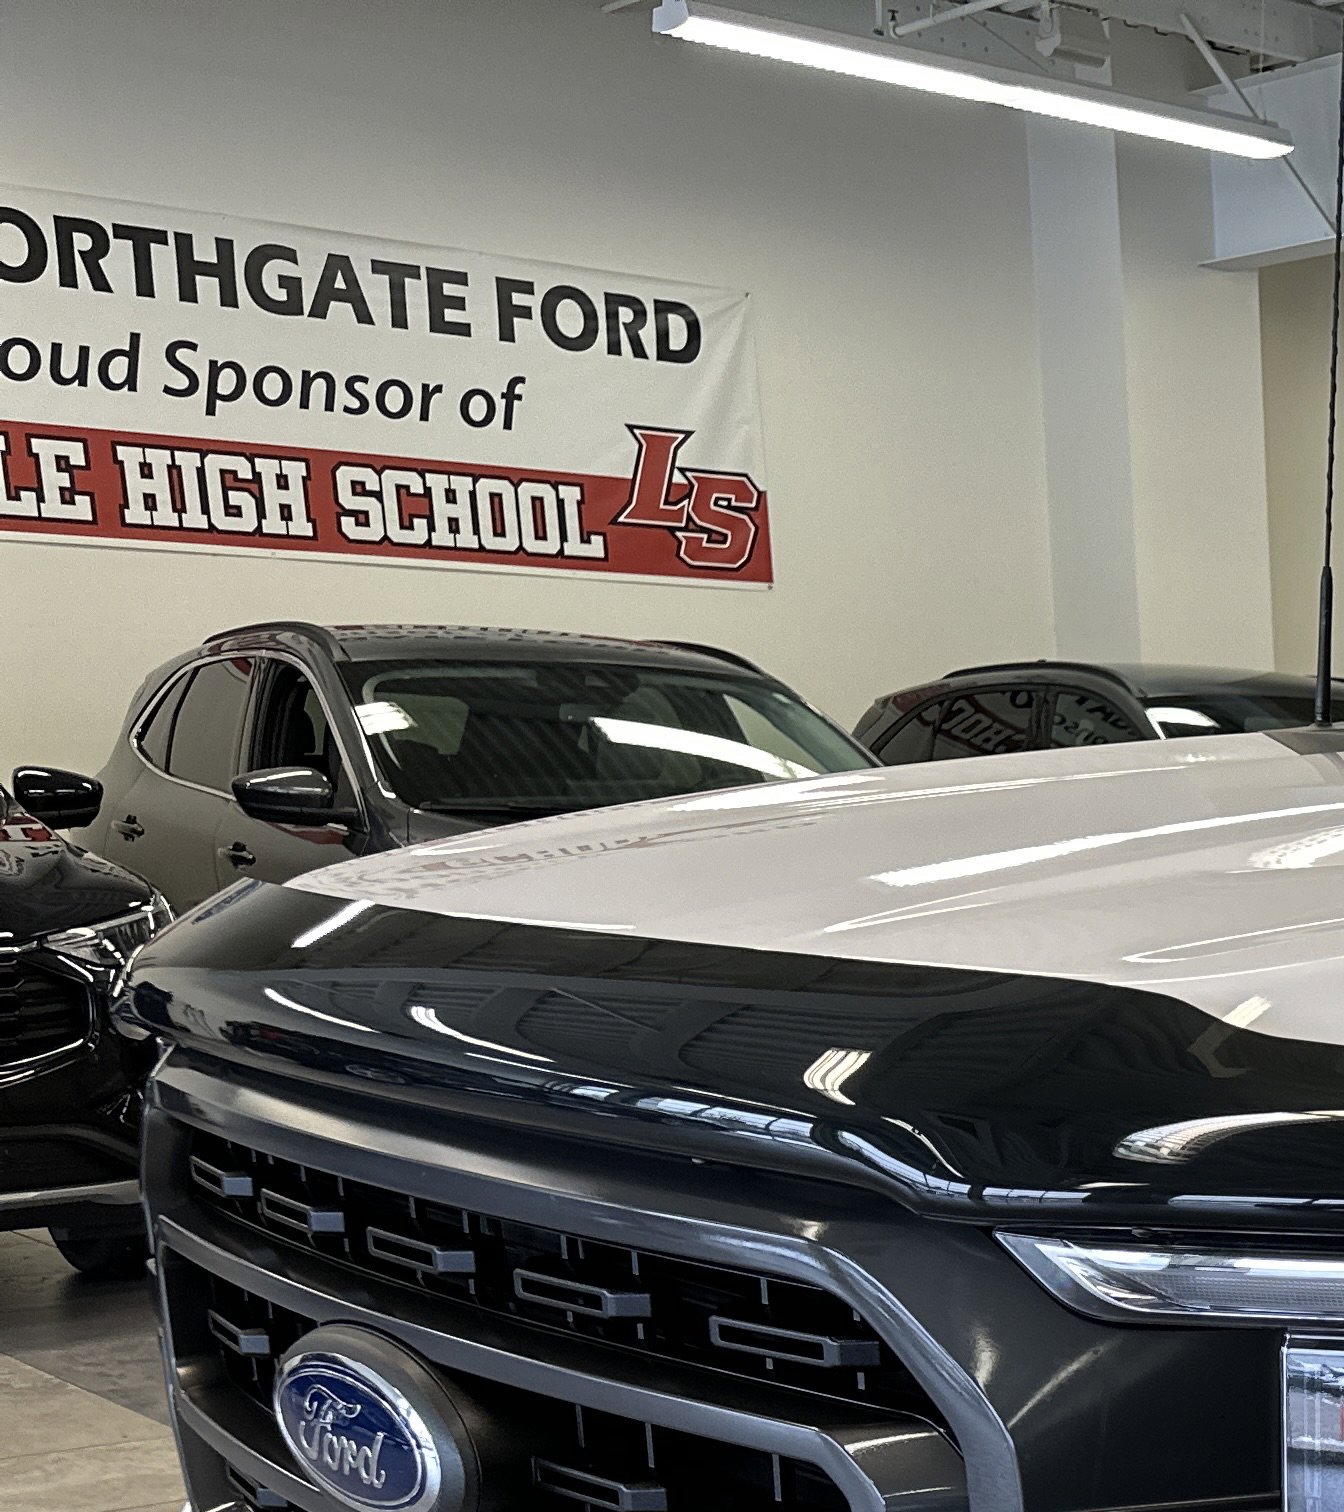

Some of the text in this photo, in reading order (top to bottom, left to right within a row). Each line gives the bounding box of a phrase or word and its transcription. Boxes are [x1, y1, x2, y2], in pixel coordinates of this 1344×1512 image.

[494, 276, 702, 364] FORD
[162, 339, 444, 422] Sponsor
[459, 375, 527, 430] of
[113, 442, 316, 540] HIGH
[332, 462, 608, 560] SCHOOL
[299, 1383, 387, 1490] Ford
